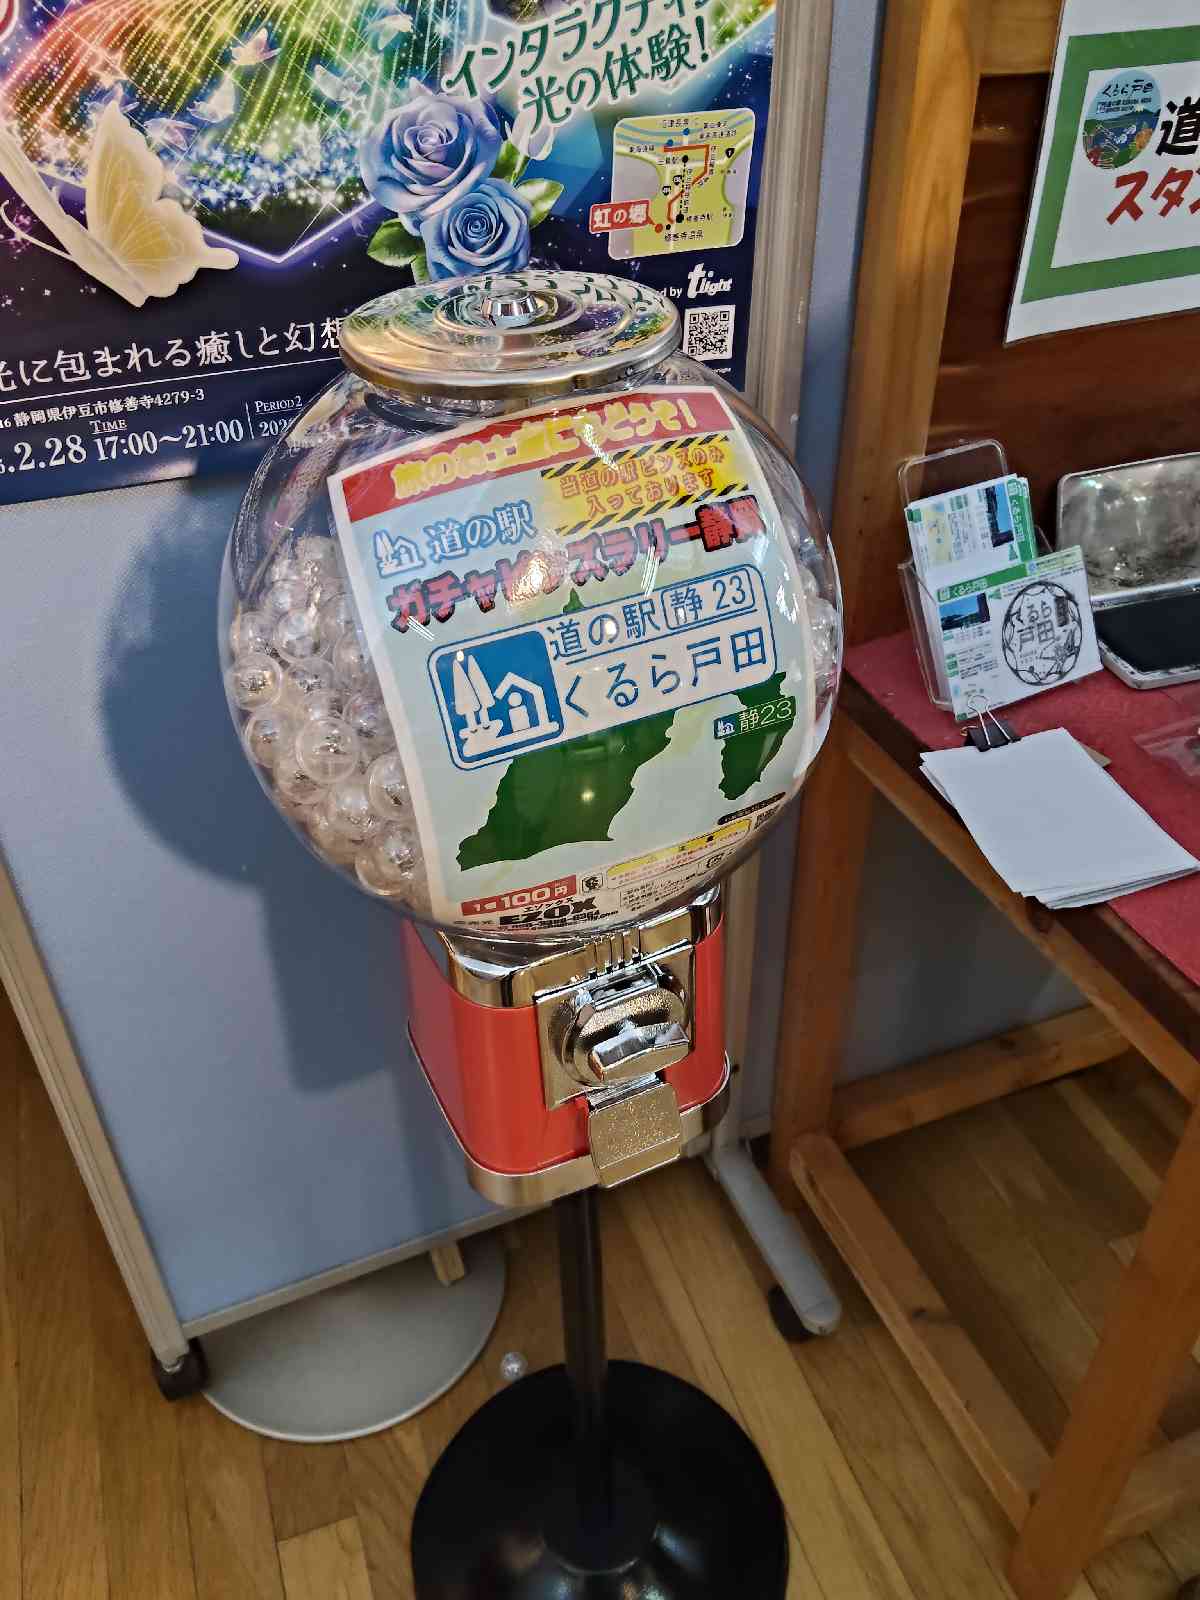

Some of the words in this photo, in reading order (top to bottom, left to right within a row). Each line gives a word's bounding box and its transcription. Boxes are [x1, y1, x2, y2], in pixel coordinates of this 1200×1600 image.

[522, 16, 710, 130] 光の体験!
[1106, 166, 1200, 226] スタ
[669, 287, 682, 298] by
[0, 434, 87, 474] .2.28
[259, 418, 296, 438] 202
[422, 500, 537, 562] 道の駅
[547, 597, 661, 661] 道の駅
[563, 626, 768, 719] くるら戸田
